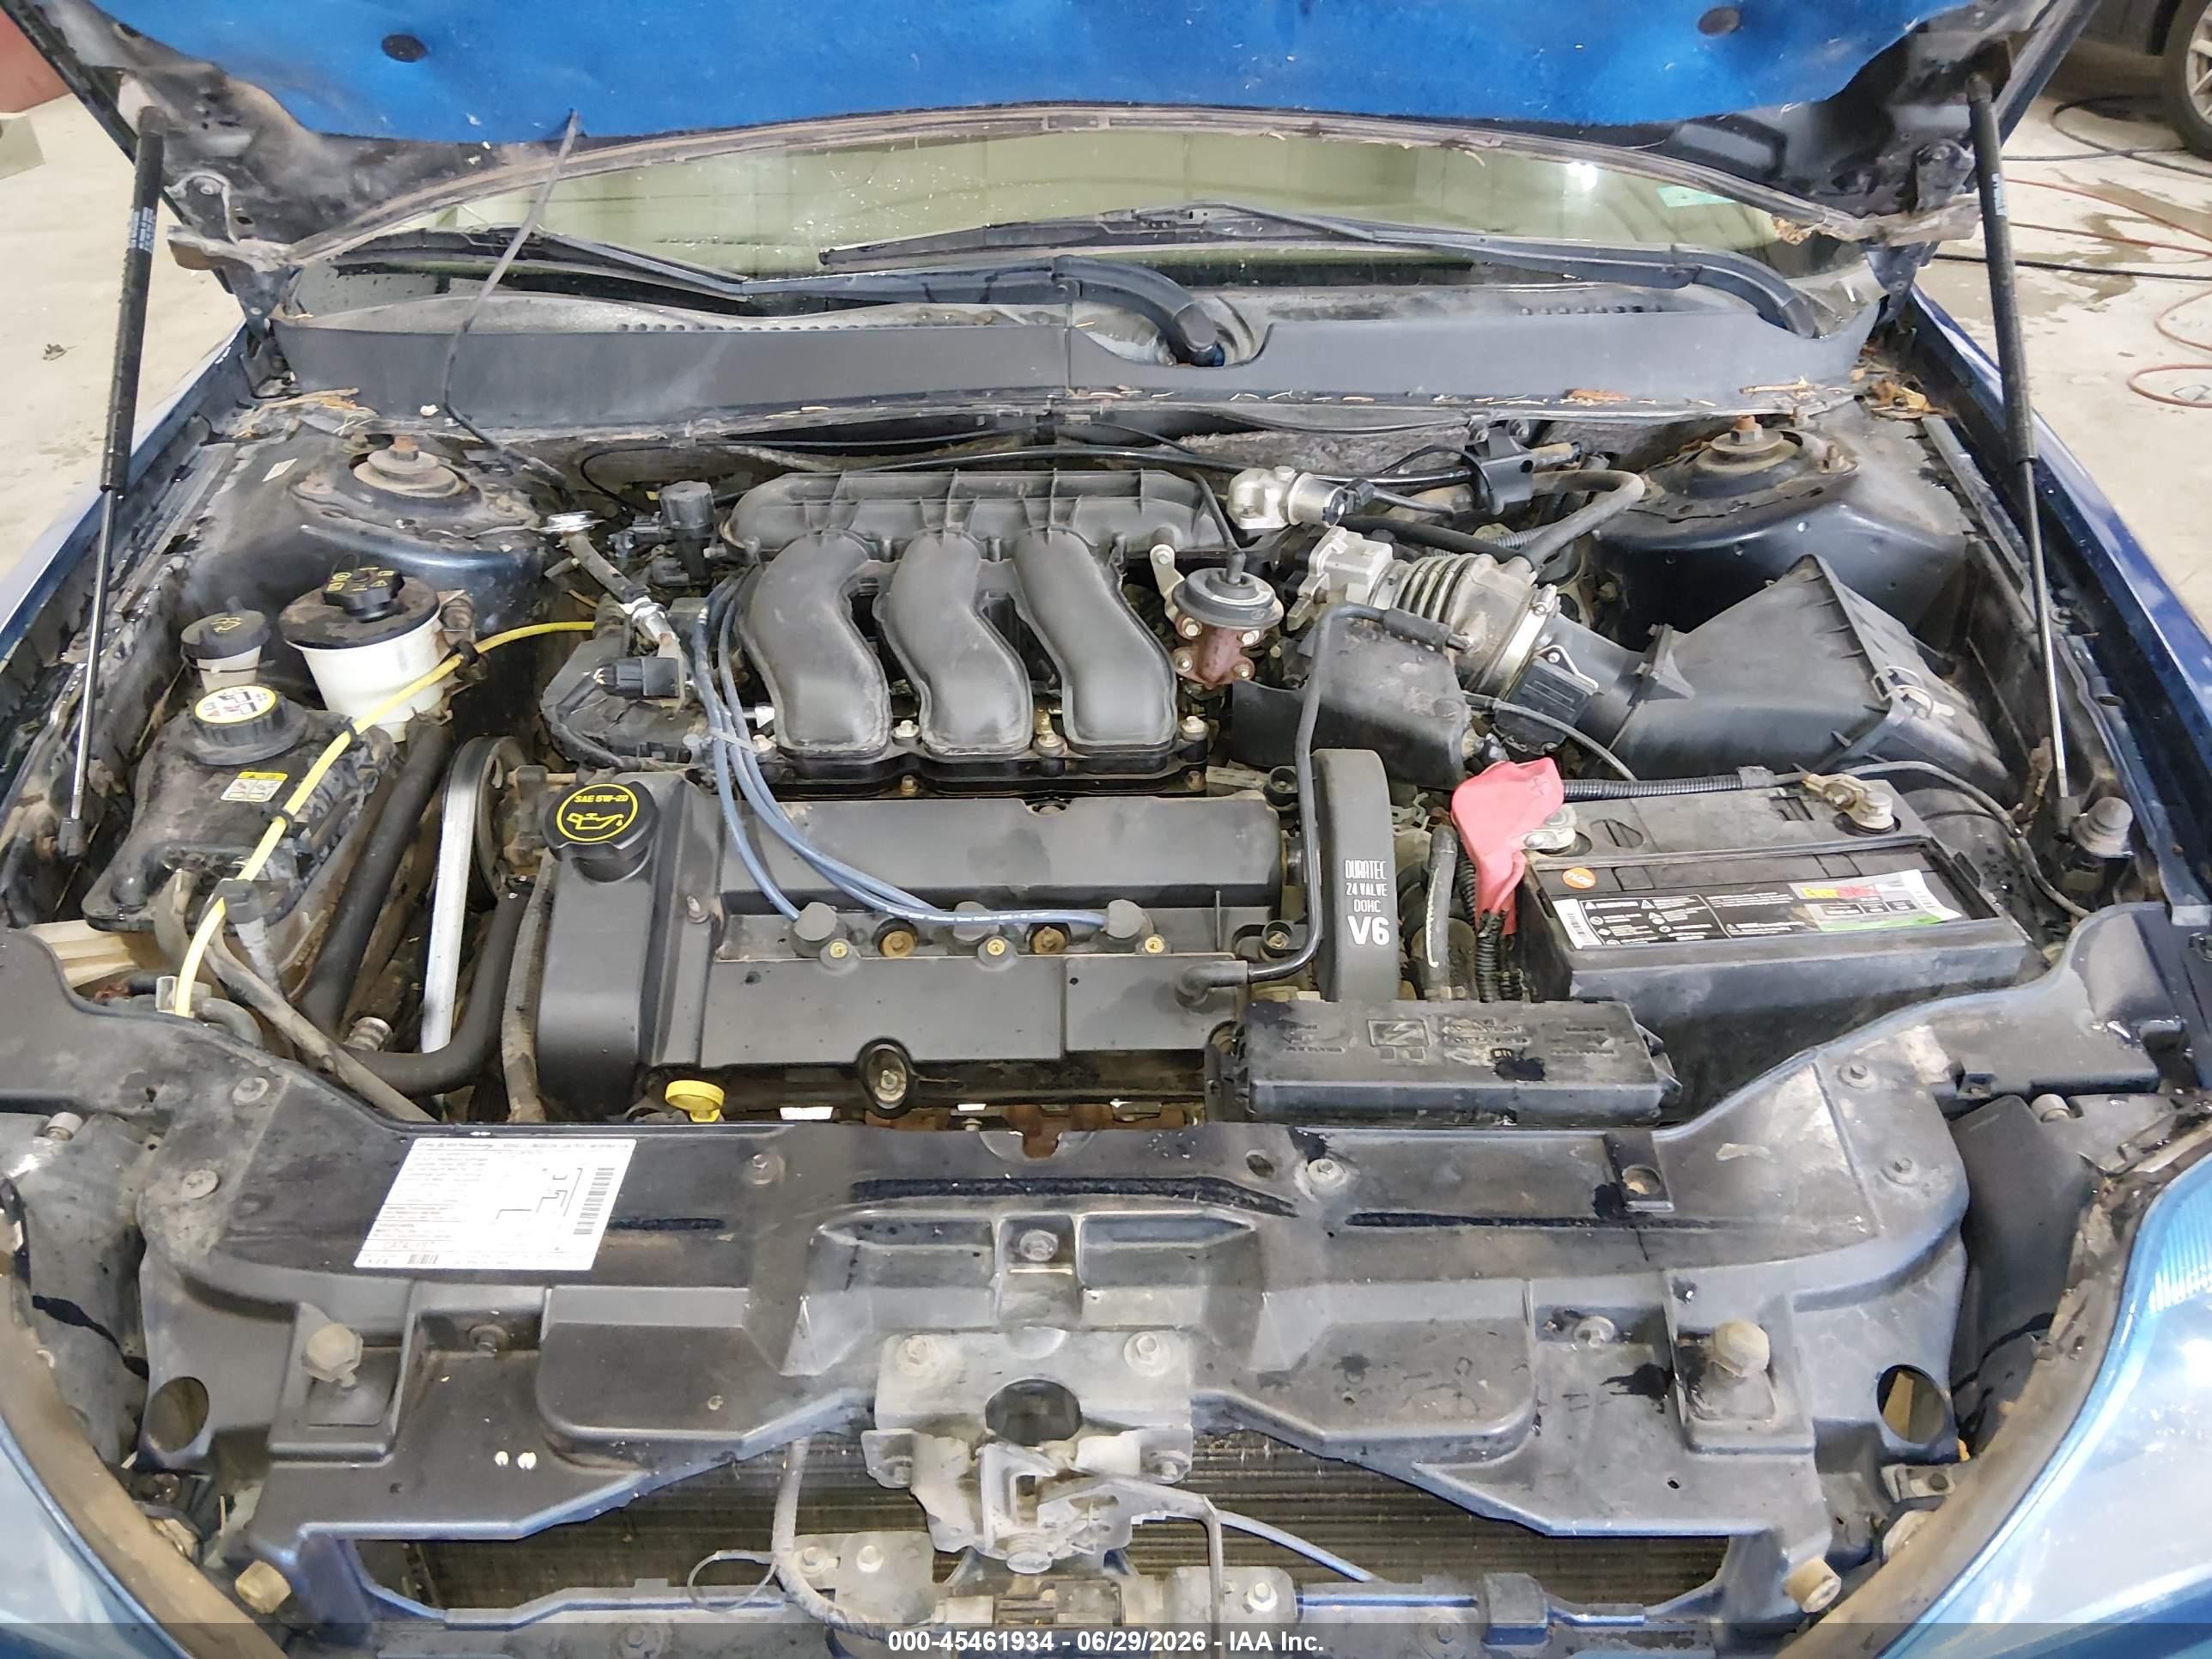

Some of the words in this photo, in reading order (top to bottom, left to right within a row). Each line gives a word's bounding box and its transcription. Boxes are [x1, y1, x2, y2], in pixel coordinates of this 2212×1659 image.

[1345, 860, 1388, 879] DURATEC
[1346, 883, 1358, 896] 24
[1359, 883, 1388, 896] VALVE
[1354, 898, 1382, 913] DOHC
[1346, 915, 1390, 945] V6
